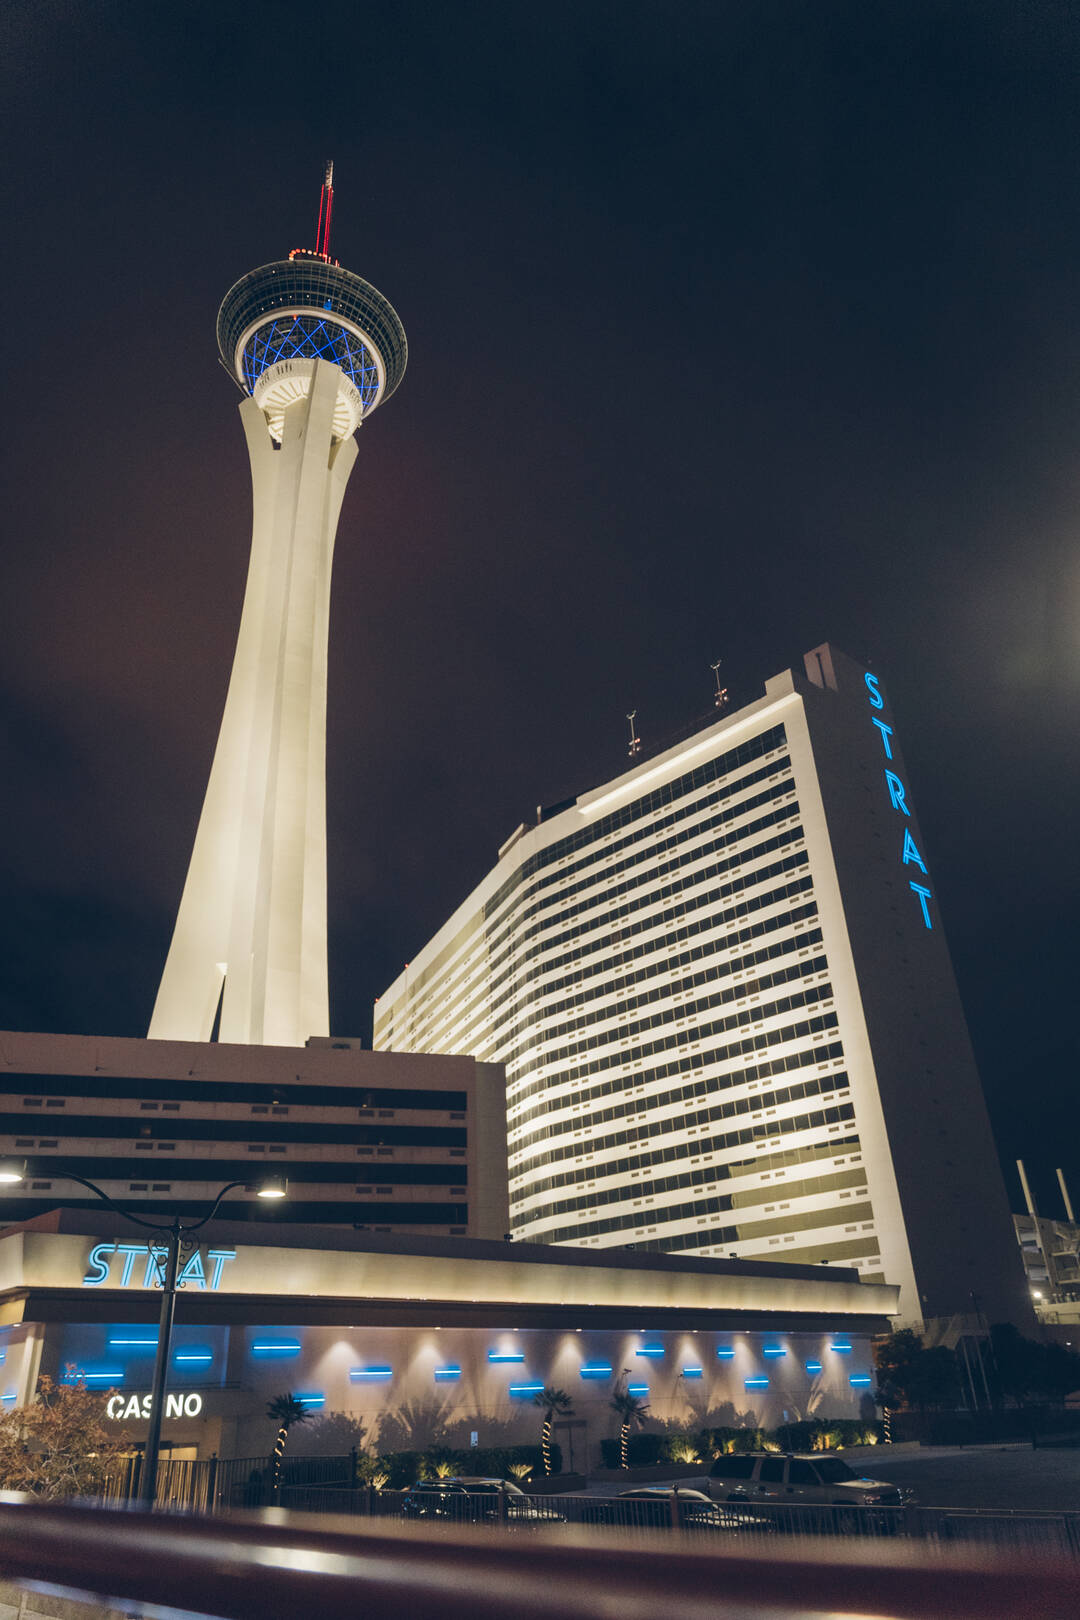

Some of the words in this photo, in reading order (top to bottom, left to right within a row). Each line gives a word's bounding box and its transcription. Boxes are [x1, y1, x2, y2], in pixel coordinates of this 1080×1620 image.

[864, 672, 932, 930] STRAT
[82, 1243, 237, 1290] STRAT
[106, 1393, 203, 1420] CASNO
